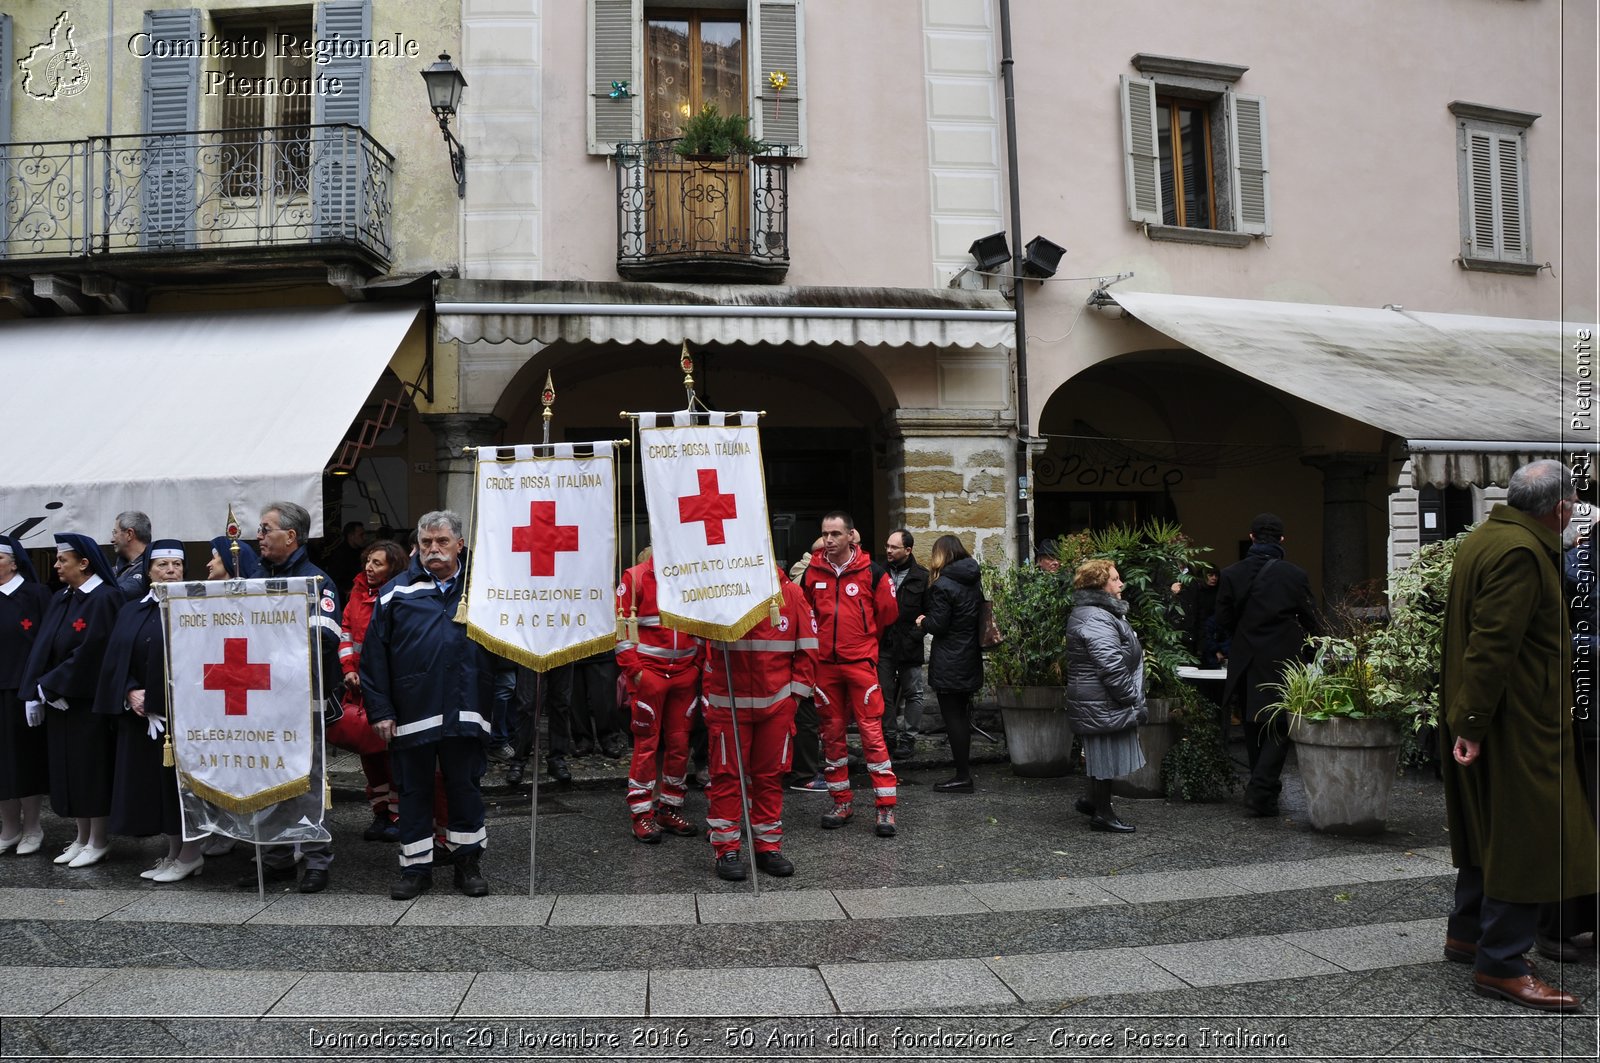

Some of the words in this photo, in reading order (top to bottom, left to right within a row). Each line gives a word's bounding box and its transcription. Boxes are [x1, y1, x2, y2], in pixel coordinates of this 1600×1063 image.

[649, 444, 678, 459] CROCE
[682, 442, 711, 457] ROSSA
[714, 441, 751, 456] ITALIANA
[485, 477, 515, 490] CROCE
[520, 475, 550, 489] ROSSA
[557, 473, 602, 489] ITALIANA
[661, 559, 724, 577] COMITATO
[727, 554, 765, 570] LOCALE
[487, 588, 582, 601] DELEGAZIONE
[589, 588, 603, 601] DI
[681, 582, 752, 604] DOMODOSSOLA
[179, 614, 207, 628] CROCE
[213, 612, 245, 626] ROSSA
[251, 610, 297, 625] ITALIANA
[499, 613, 587, 628] BACENO
[187, 729, 275, 742] DELEGAZIONE
[283, 730, 297, 742] DI
[199, 754, 286, 770] ANTRONA
